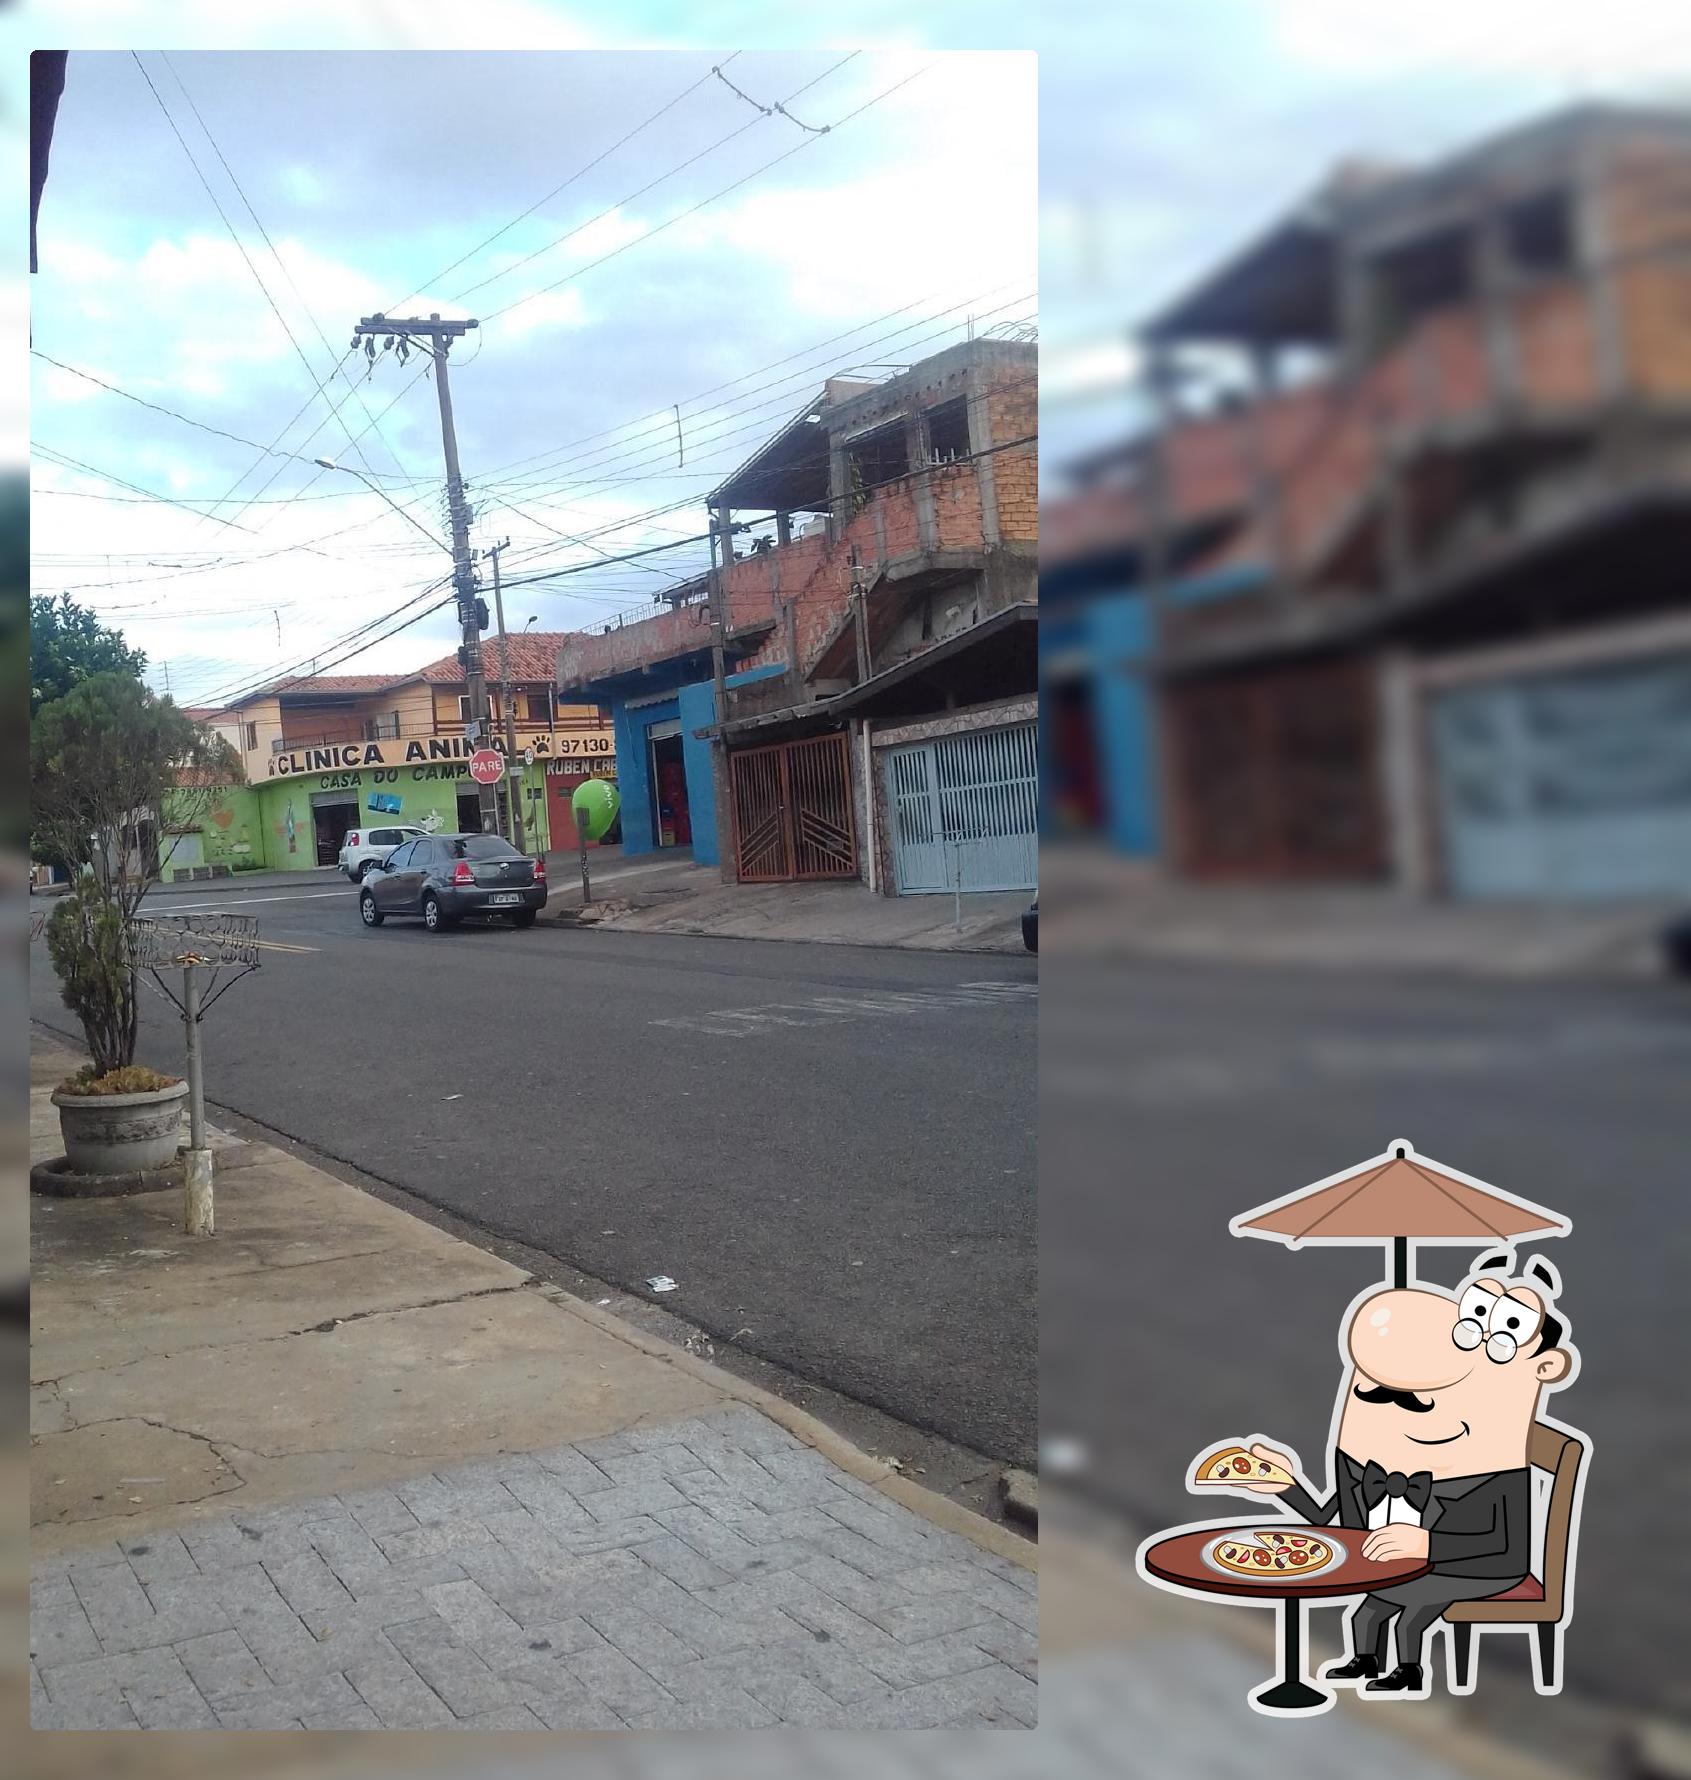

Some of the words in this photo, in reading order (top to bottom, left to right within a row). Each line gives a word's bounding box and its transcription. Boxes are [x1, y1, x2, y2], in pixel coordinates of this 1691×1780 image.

[561, 739, 616, 754] 97130-
[279, 744, 385, 775] CLINICA
[472, 760, 502, 773] PARE
[547, 759, 590, 776] RUBEN
[320, 771, 362, 789] CASA
[373, 768, 399, 784] DO
